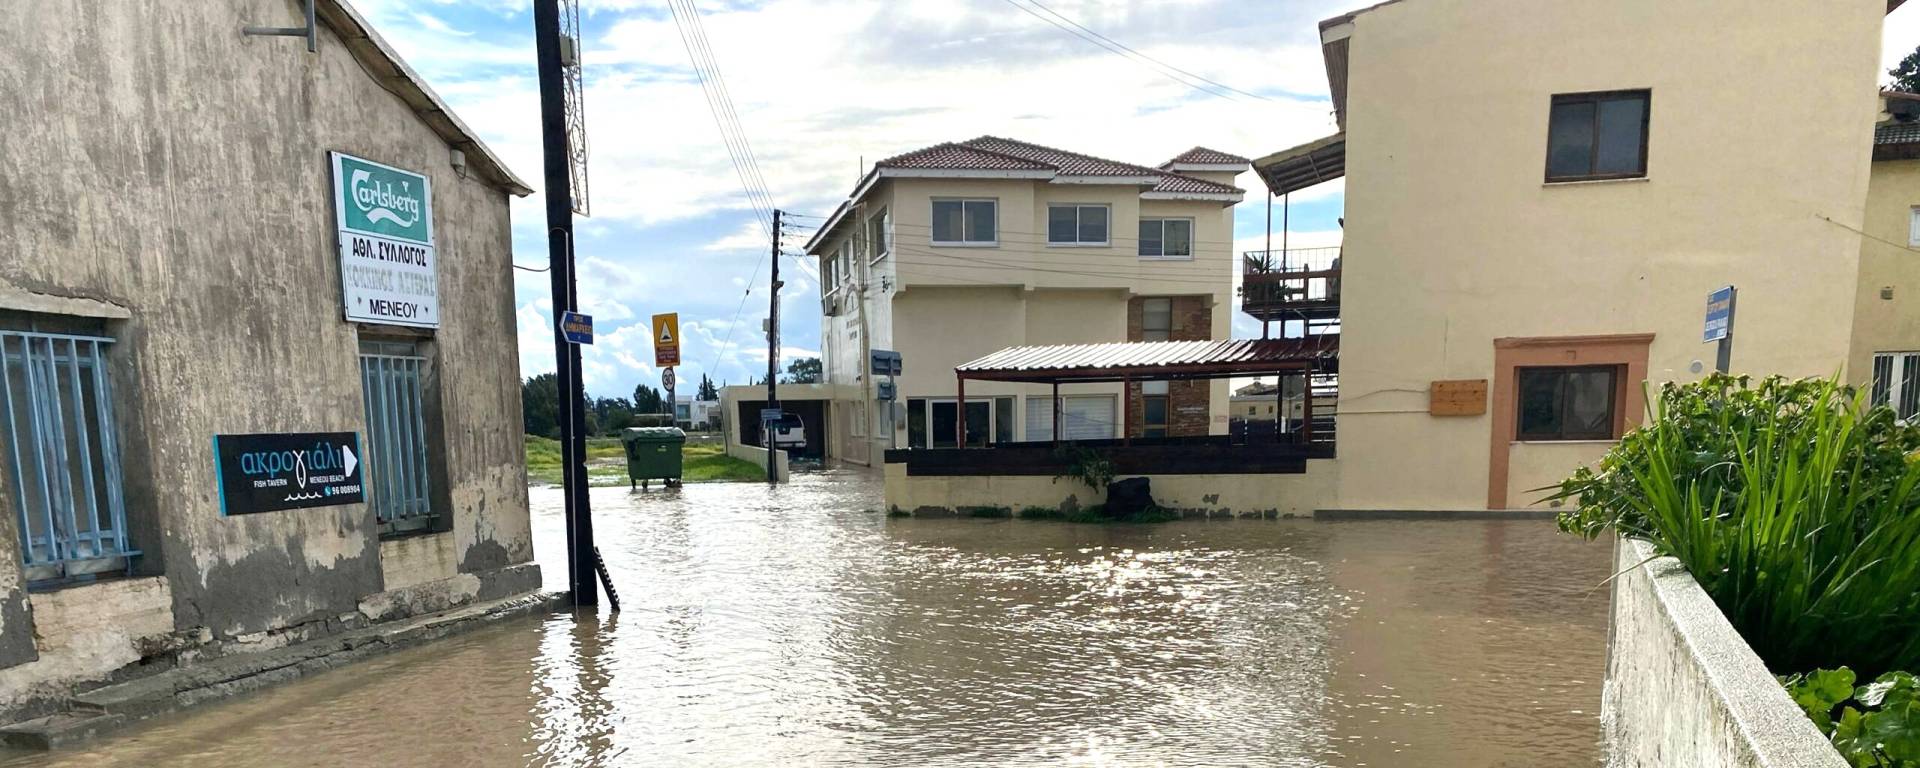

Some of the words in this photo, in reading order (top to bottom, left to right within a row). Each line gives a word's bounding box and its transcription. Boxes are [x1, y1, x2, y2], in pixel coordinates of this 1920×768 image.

[351, 168, 419, 223] Carlsberg
[352, 237, 376, 260] ΑΘΛ.
[378, 241, 427, 267] ΣΥΛΛΟΓΟΣ
[369, 299, 418, 318] ΜΕΝΕΟΥ
[241, 442, 343, 489] ακρογιάλι
[254, 480, 266, 488] FISH
[267, 478, 288, 487] TAVERN
